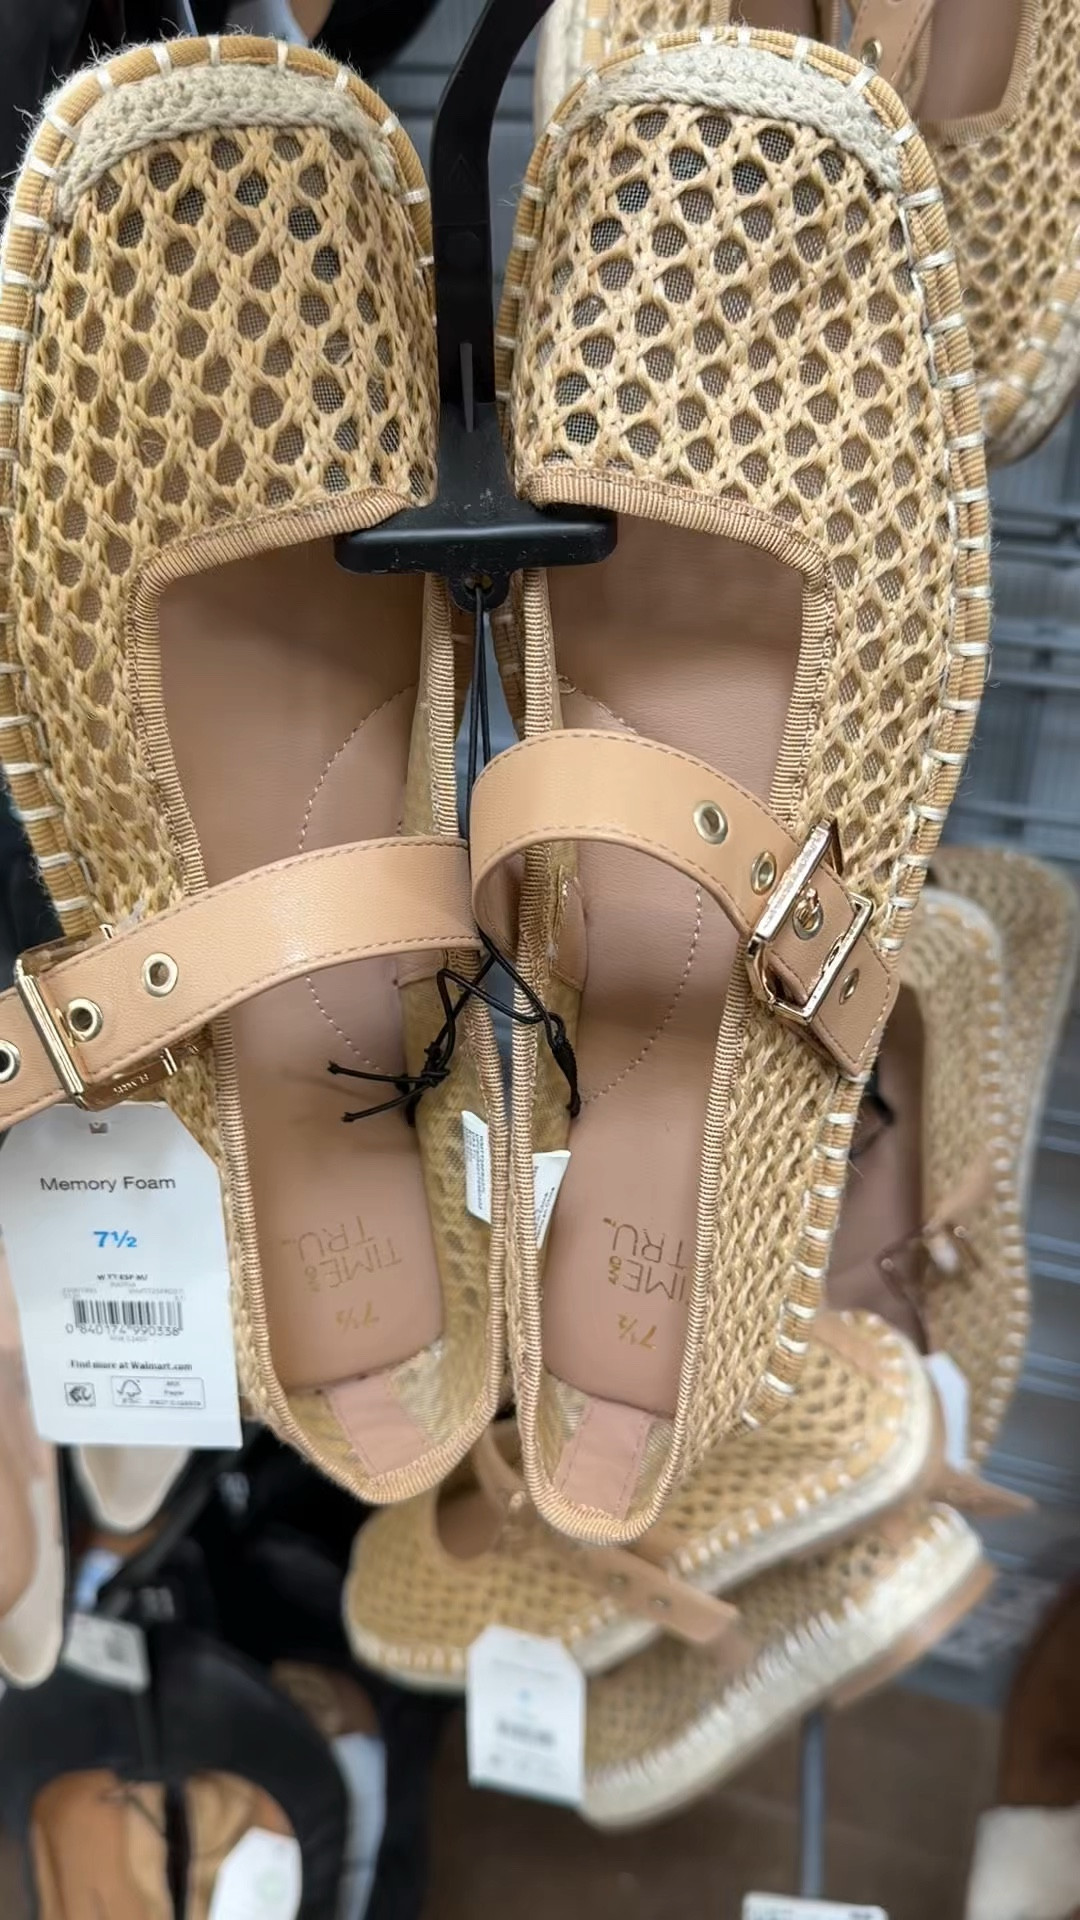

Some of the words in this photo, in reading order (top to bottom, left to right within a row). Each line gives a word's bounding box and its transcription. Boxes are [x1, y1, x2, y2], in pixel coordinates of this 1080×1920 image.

[40, 1177, 117, 1193] Memory
[123, 1176, 177, 1190] Foam
[299, 1215, 375, 1262] TRU
[612, 1223, 688, 1270] TRU
[319, 1236, 403, 1289] TIME
[622, 1259, 690, 1307] IME
[70, 1359, 91, 1369] Find
[92, 1361, 117, 1369] more
[119, 1361, 130, 1370] at
[131, 1361, 193, 1371] Walmart.com
